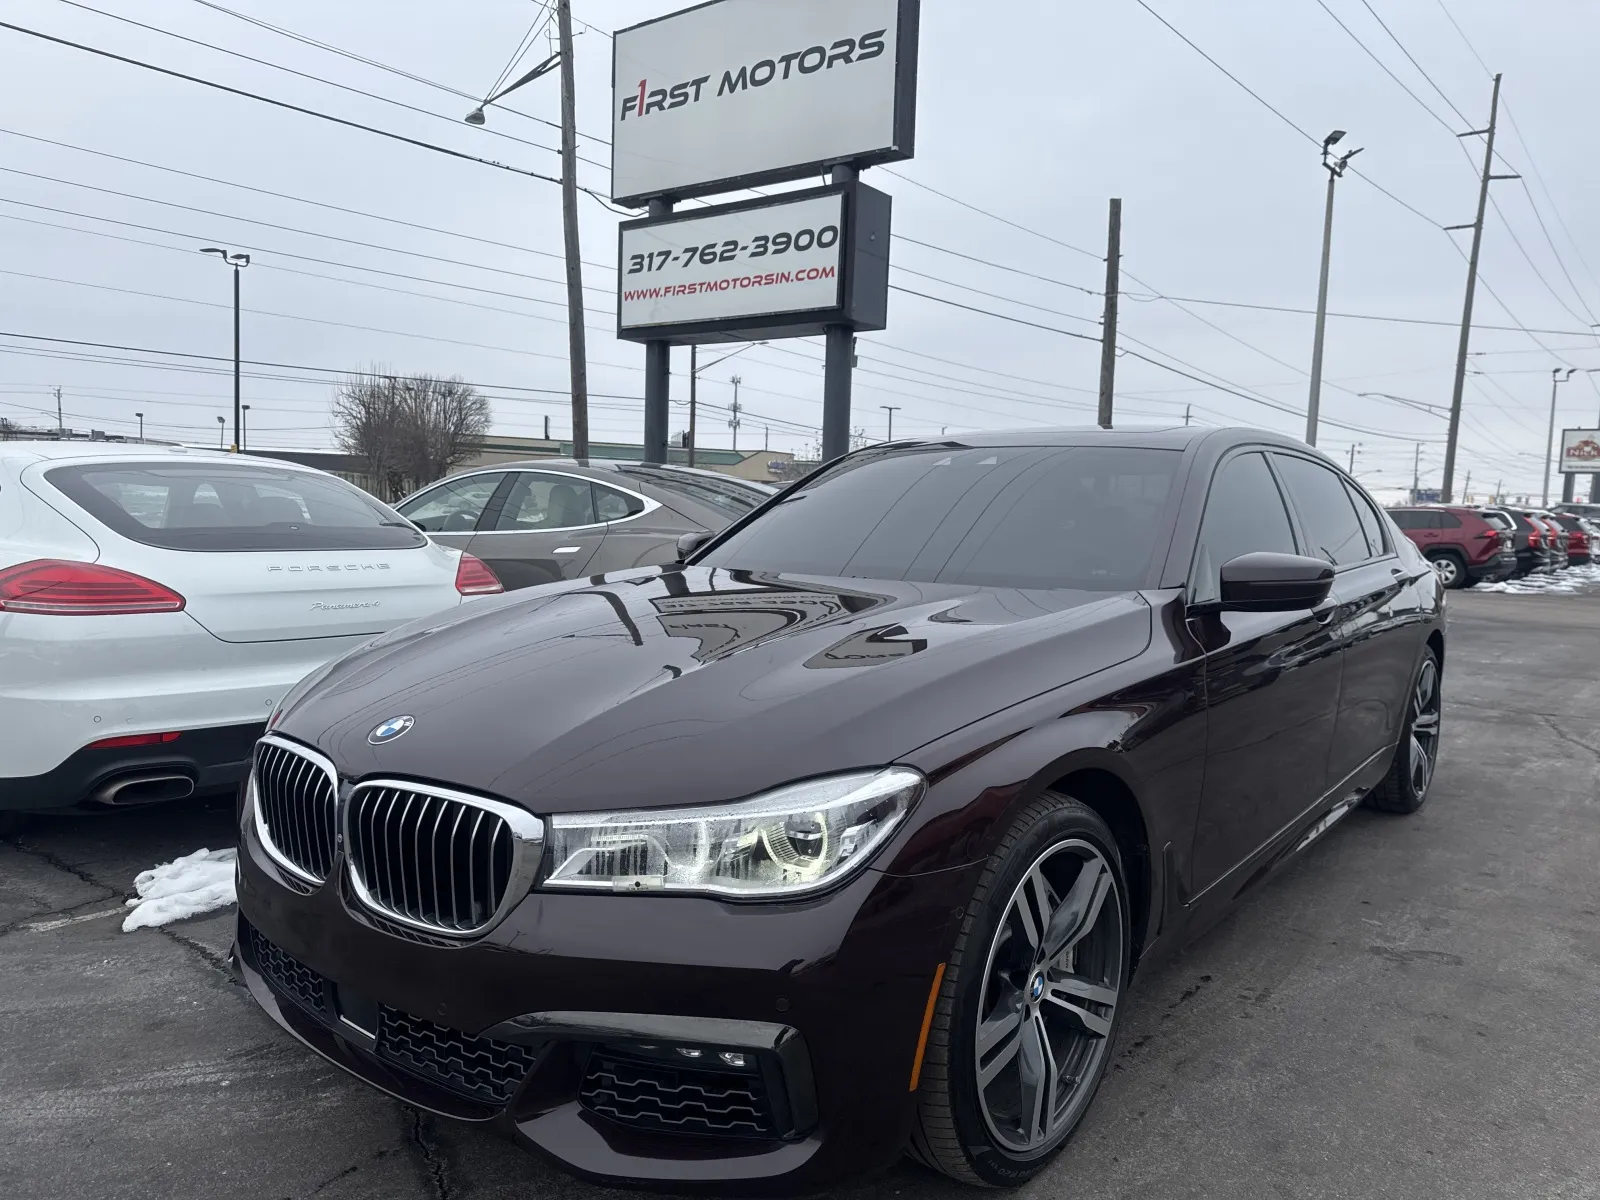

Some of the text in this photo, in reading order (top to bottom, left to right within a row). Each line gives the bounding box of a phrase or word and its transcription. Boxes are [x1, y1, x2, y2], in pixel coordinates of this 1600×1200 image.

[717, 29, 887, 97] MOTORS
[627, 225, 839, 275] 317-762-3900
[624, 266, 835, 301] WWW.FIRSTMOTORSIN.COM
[268, 563, 390, 572] PORSCHE
